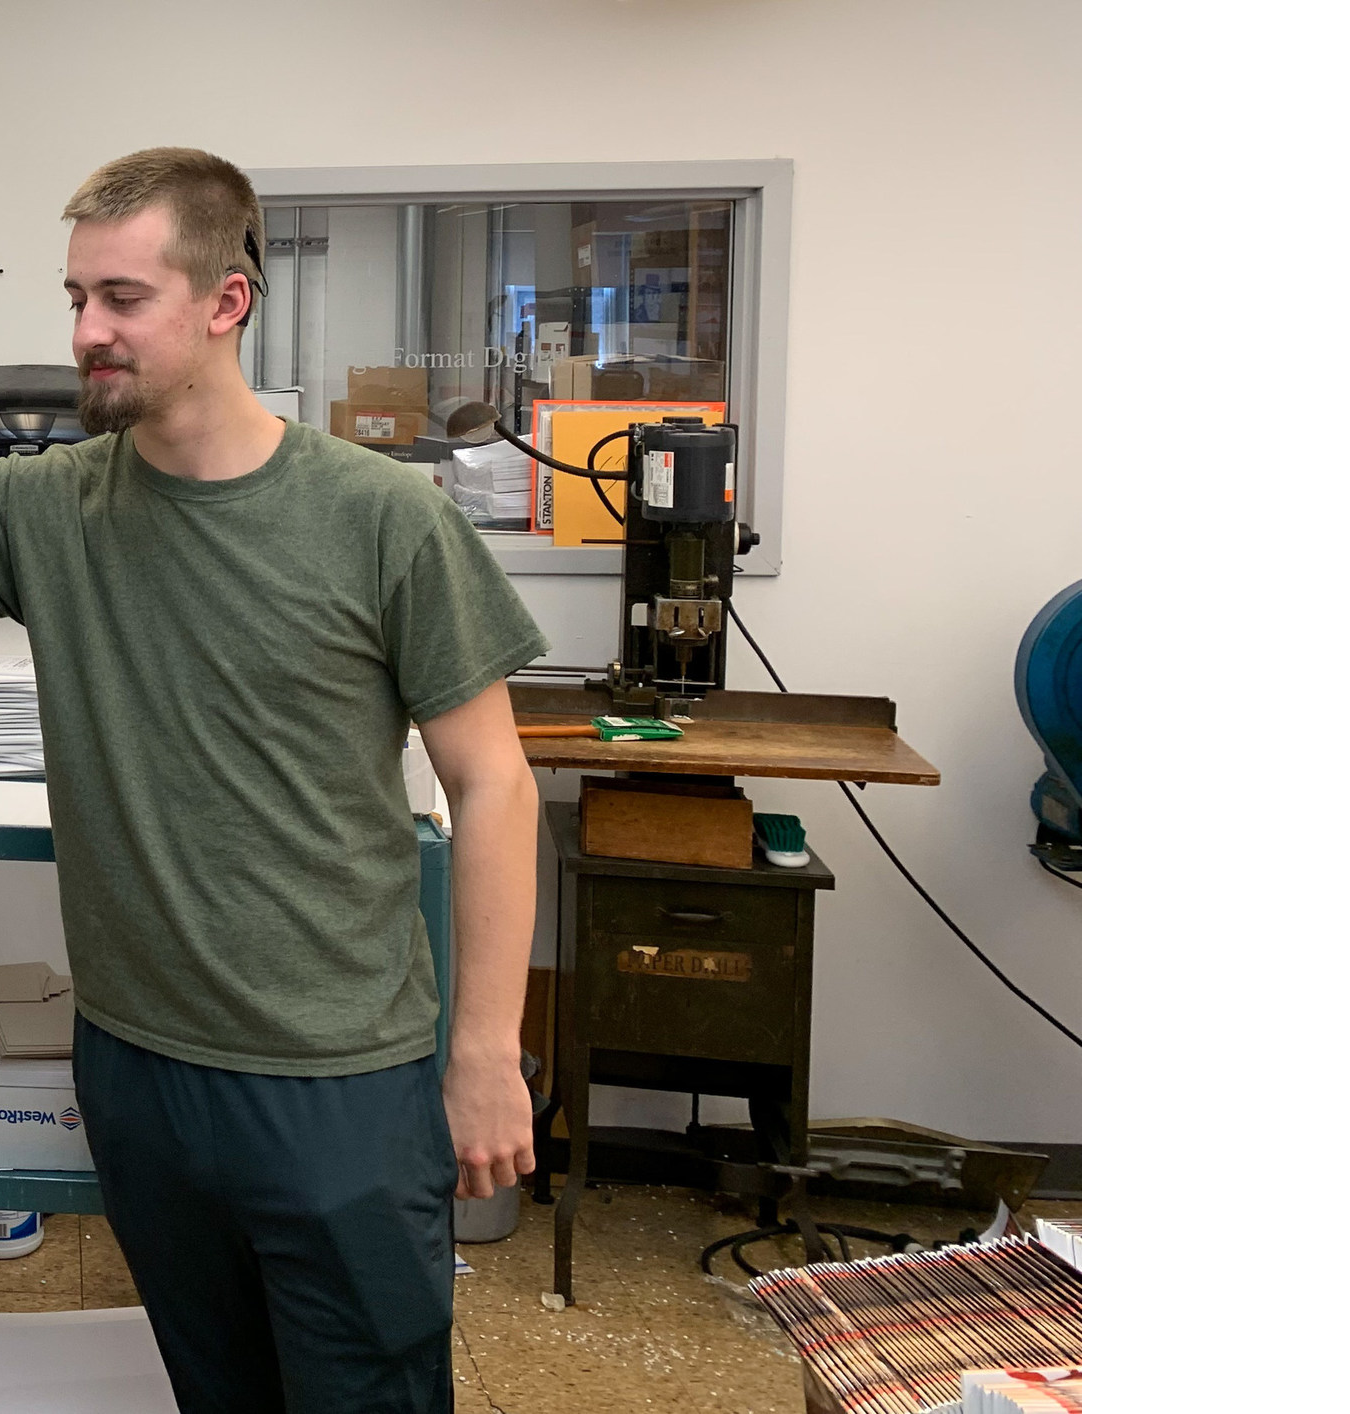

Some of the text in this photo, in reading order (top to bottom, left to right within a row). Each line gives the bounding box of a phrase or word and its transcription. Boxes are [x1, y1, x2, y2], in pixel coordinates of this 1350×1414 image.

[541, 475, 553, 525] STANTON
[627, 952, 742, 977] PER DILL
